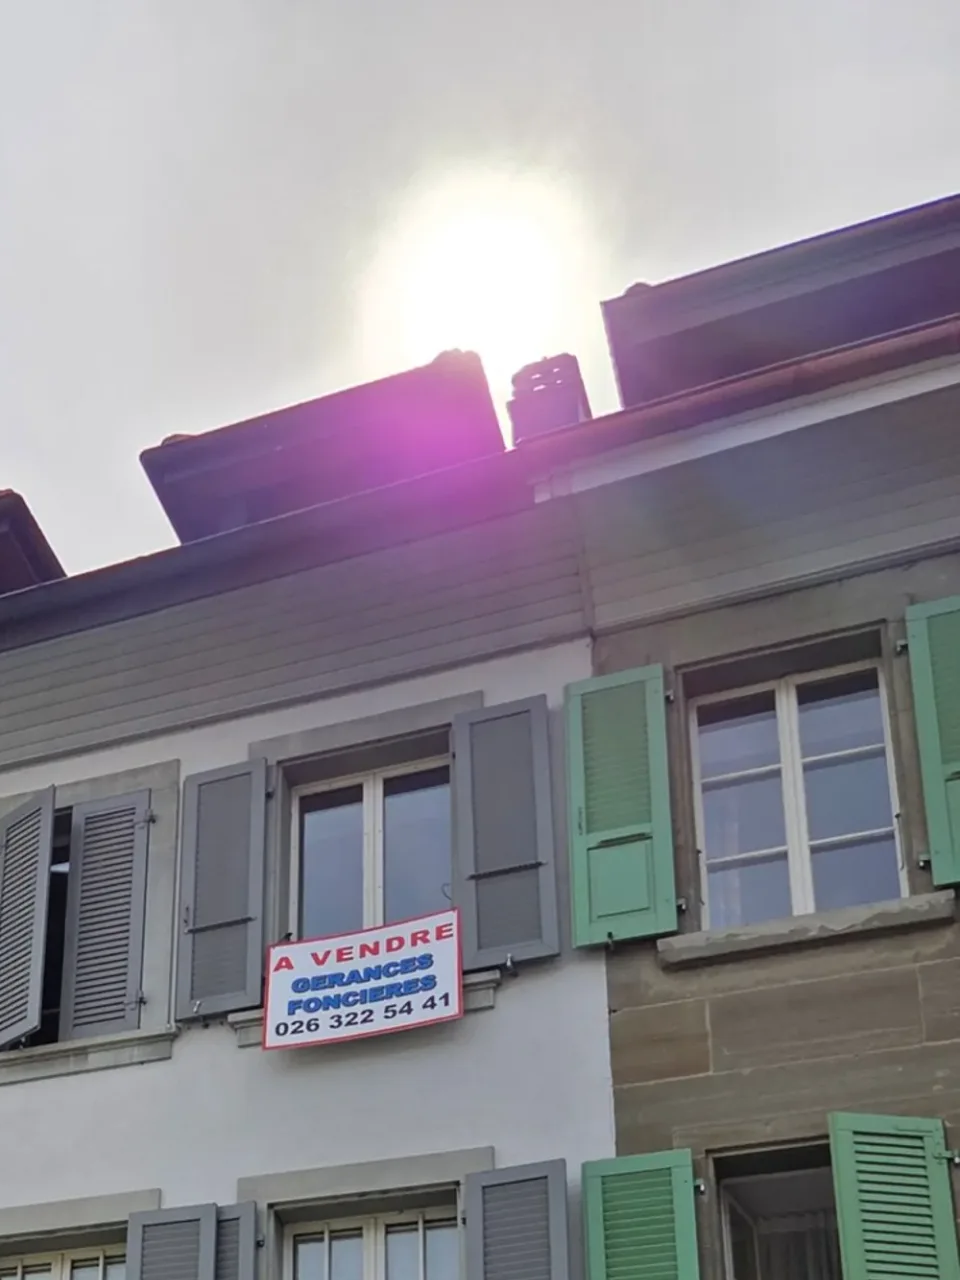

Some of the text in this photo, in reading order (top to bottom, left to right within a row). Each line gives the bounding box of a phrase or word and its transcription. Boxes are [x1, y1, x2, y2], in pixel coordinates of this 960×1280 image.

[273, 923, 454, 972] A VENDRE
[287, 974, 437, 1016] FONCIERES
[291, 953, 434, 994] GERANCES
[275, 992, 451, 1037] 026 322 54 41
